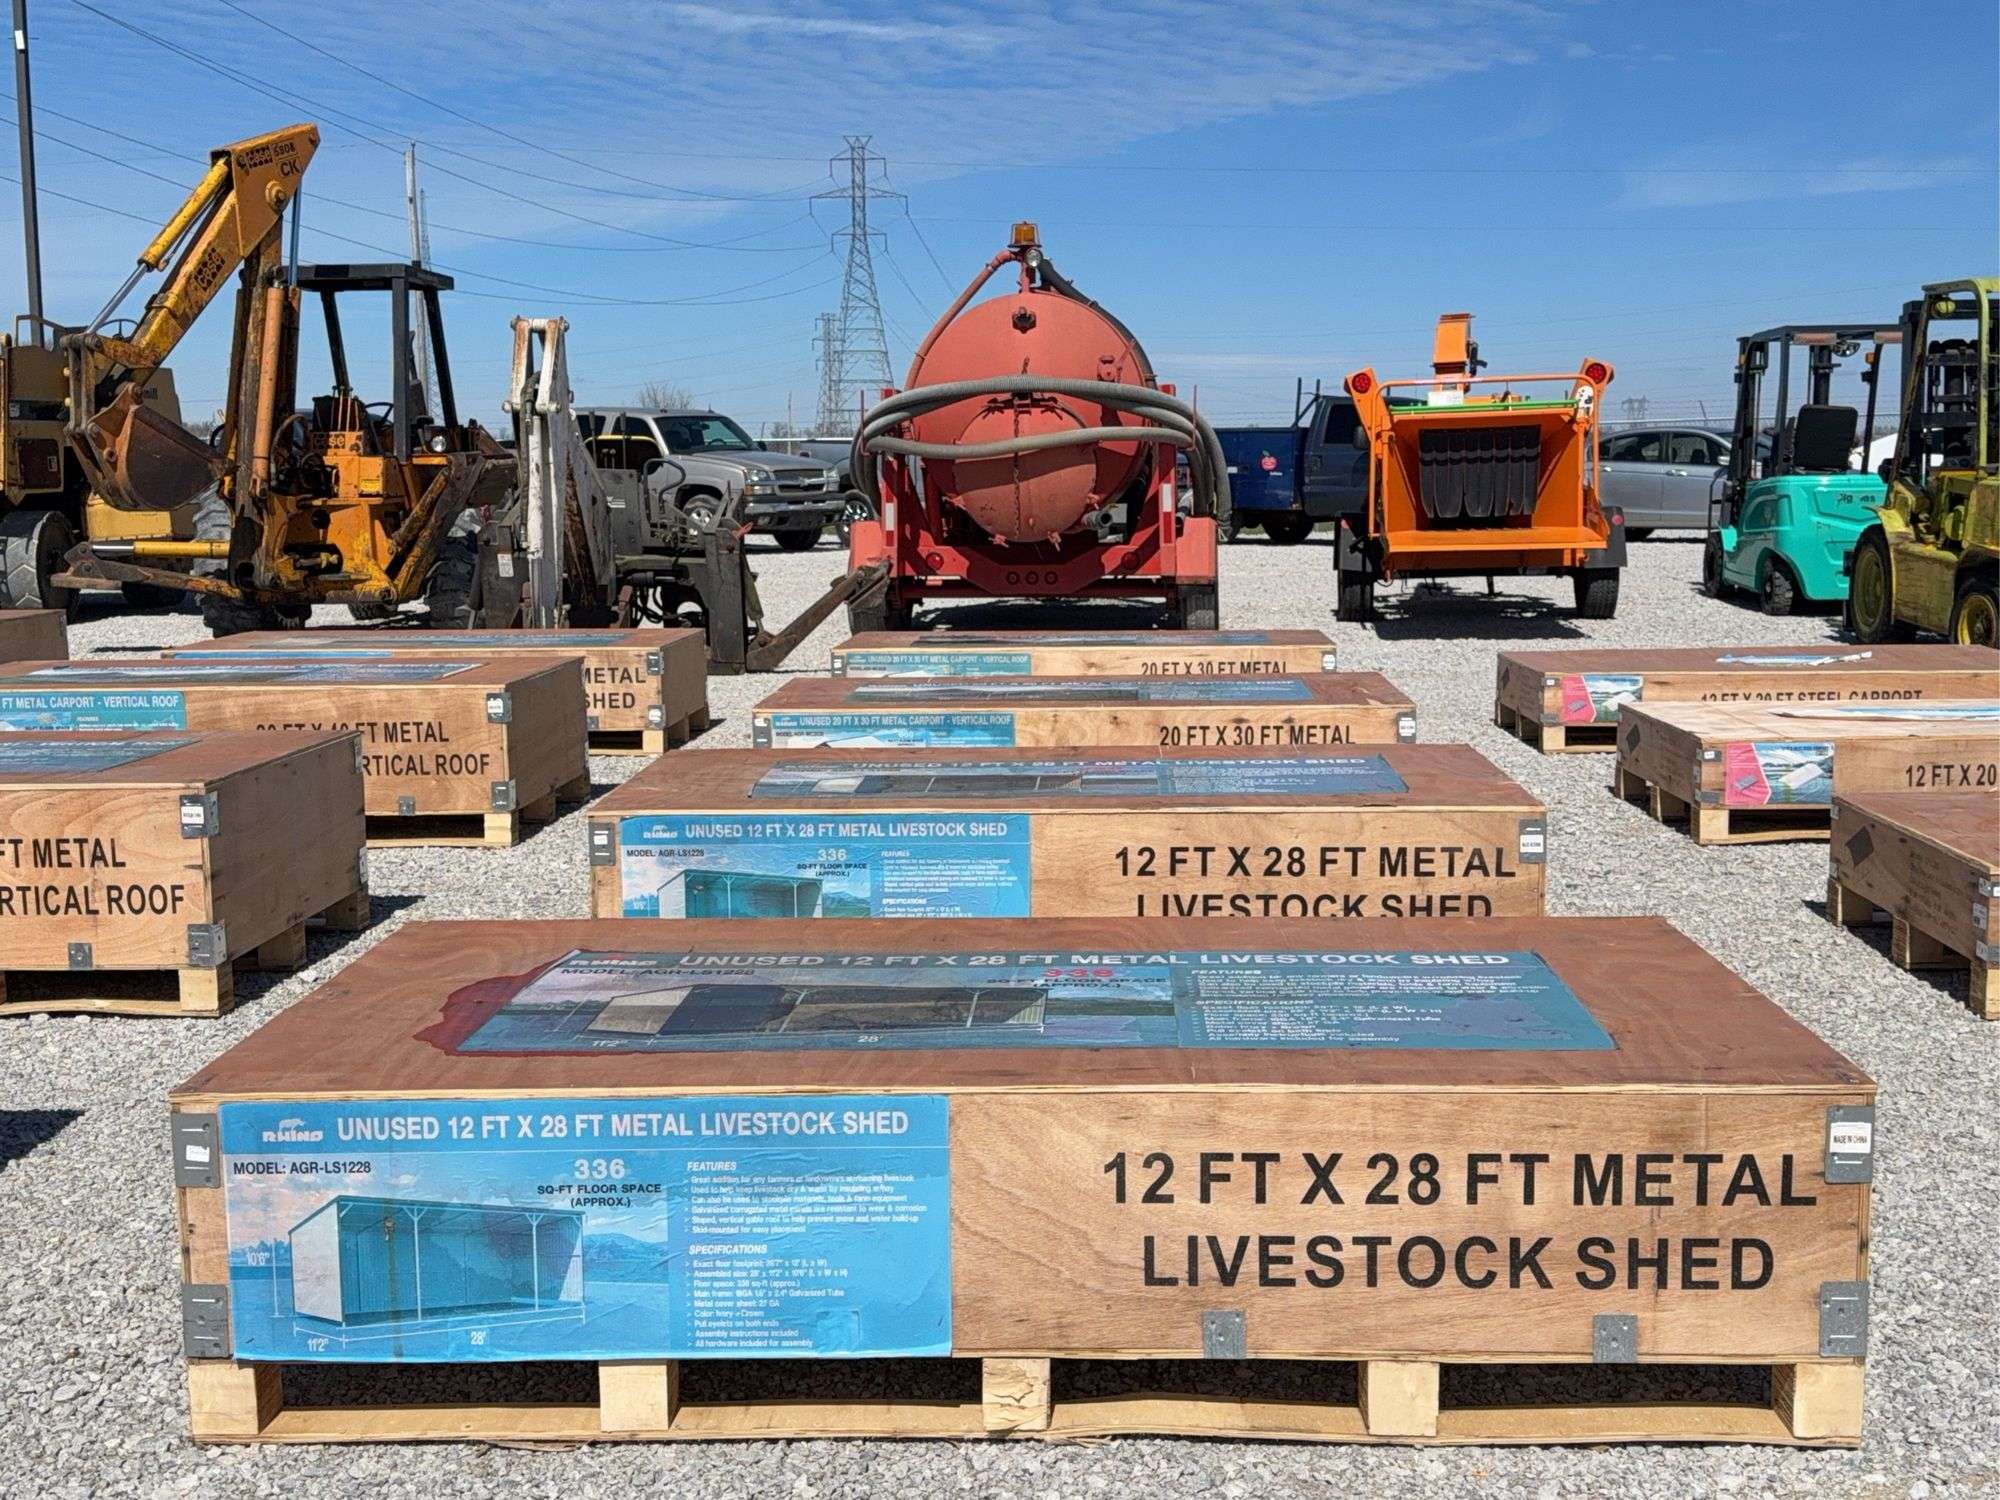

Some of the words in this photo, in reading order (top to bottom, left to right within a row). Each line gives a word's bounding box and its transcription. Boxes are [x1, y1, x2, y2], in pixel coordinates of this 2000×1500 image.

[280, 158, 301, 177] CK
[1141, 661, 1158, 675] 20
[1162, 661, 1180, 675] FT
[1184, 661, 1193, 675] X
[1197, 661, 1214, 675] 30
[1217, 661, 1236, 675] FT
[1240, 661, 1287, 675] METAL
[2, 696, 13, 709] FT
[16, 696, 48, 709] METAL
[50, 696, 95, 709] CARPORT
[103, 696, 150, 709] VERTICAL
[152, 696, 179, 709] ROOF
[384, 721, 450, 743] METAL
[1159, 725, 1180, 746] 20
[1187, 725, 1210, 746] FT
[1216, 725, 1228, 746] X
[1233, 725, 1255, 746] 30
[1261, 725, 1284, 746] FT
[1289, 725, 1356, 746] METAL
[435, 753, 490, 775] ROOF
[1906, 764, 1926, 787] 12
[1931, 764, 1955, 787] FT
[1959, 764, 1971, 787] X
[1976, 764, 1997, 787] 20
[685, 824, 741, 839] UNUSED
[747, 823, 764, 838] 12
[766, 823, 783, 838] FT
[784, 823, 798, 838] X
[799, 823, 816, 838] 28
[818, 823, 837, 838] FT
[839, 823, 886, 838] METAL
[889, 823, 967, 838] LIVESTOCK
[969, 823, 1008, 838] SHED
[32, 838, 126, 868] METAL
[817, 849, 848, 861] 336
[1114, 846, 1157, 877] 12
[1169, 846, 1216, 877] FT
[1226, 846, 1253, 877] X
[1263, 846, 1307, 877] 28
[1320, 846, 1366, 877] FT
[1380, 846, 1517, 877] METAL
[106, 884, 185, 915] ROOF
[1136, 894, 1370, 917] LIVESTOCK
[1380, 894, 1492, 917] SHED
[679, 956, 824, 968] UNUSED
[838, 955, 873, 968] 12
[885, 955, 926, 967] FT
[934, 955, 959, 967] X
[967, 955, 1008, 967] 28
[1018, 954, 1061, 966] FT
[1070, 954, 1189, 965] METAL
[1200, 953, 1399, 965] LIVESTOCK
[1411, 953, 1510, 965] SHED
[337, 1117, 440, 1141] UNUSED
[447, 1117, 474, 1139] 12
[482, 1116, 511, 1138] FT
[516, 1116, 534, 1138] X
[540, 1115, 569, 1138] 28
[575, 1114, 603, 1137] FT
[611, 1113, 694, 1136] METAL
[701, 1111, 836, 1136] LIVESTOCK
[842, 1111, 909, 1135] SHED
[233, 1162, 286, 1174] MODEL:
[290, 1161, 371, 1174] AGR-LS1228
[573, 1158, 626, 1180] 336
[687, 1161, 737, 1172] FEATURES
[537, 1184, 573, 1195] SQ-FT
[577, 1184, 618, 1195] FLOOR
[621, 1183, 663, 1194] SPACE
[1104, 1152, 1175, 1204] 12
[1200, 1152, 1281, 1204] FT
[1300, 1152, 1345, 1204] X
[1365, 1151, 1441, 1205] 28
[1466, 1153, 1553, 1205] FT
[1573, 1153, 1818, 1207] METAL
[570, 1197, 632, 1209] (APPROX.)
[689, 1244, 768, 1255] SPECIFICATIONS
[1143, 1234, 1555, 1290] LIVESTOCK
[1575, 1236, 1776, 1291] SHED
[470, 1330, 488, 1345] 28'
